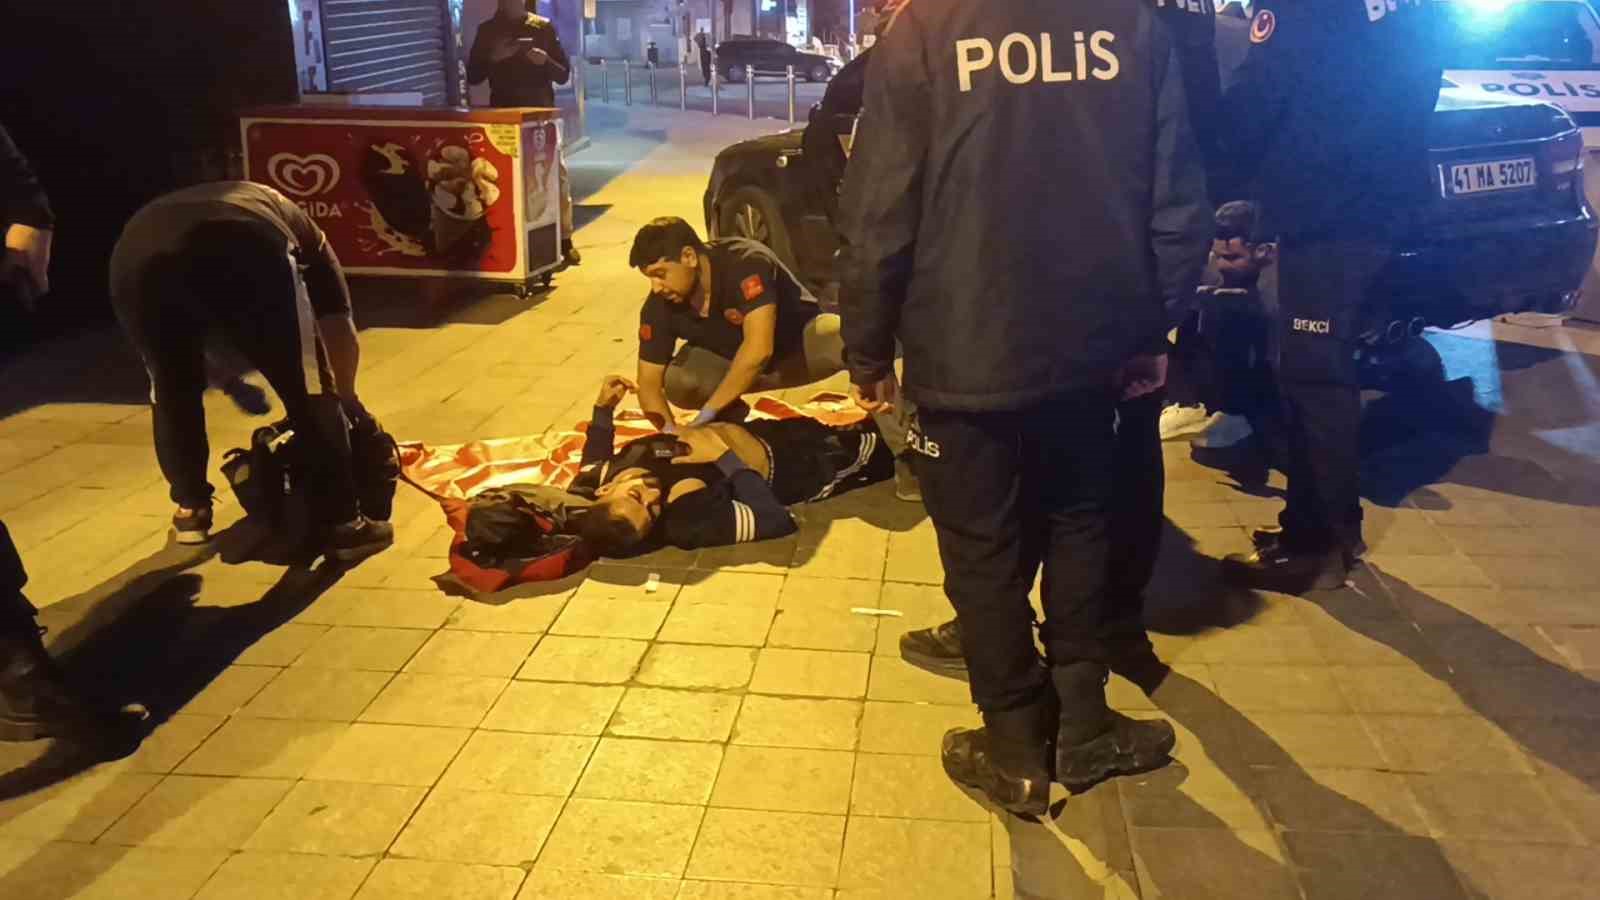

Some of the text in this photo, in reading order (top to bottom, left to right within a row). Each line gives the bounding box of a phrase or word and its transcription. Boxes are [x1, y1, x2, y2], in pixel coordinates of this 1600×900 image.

[1454, 161, 1532, 190] 41 MA 5207
